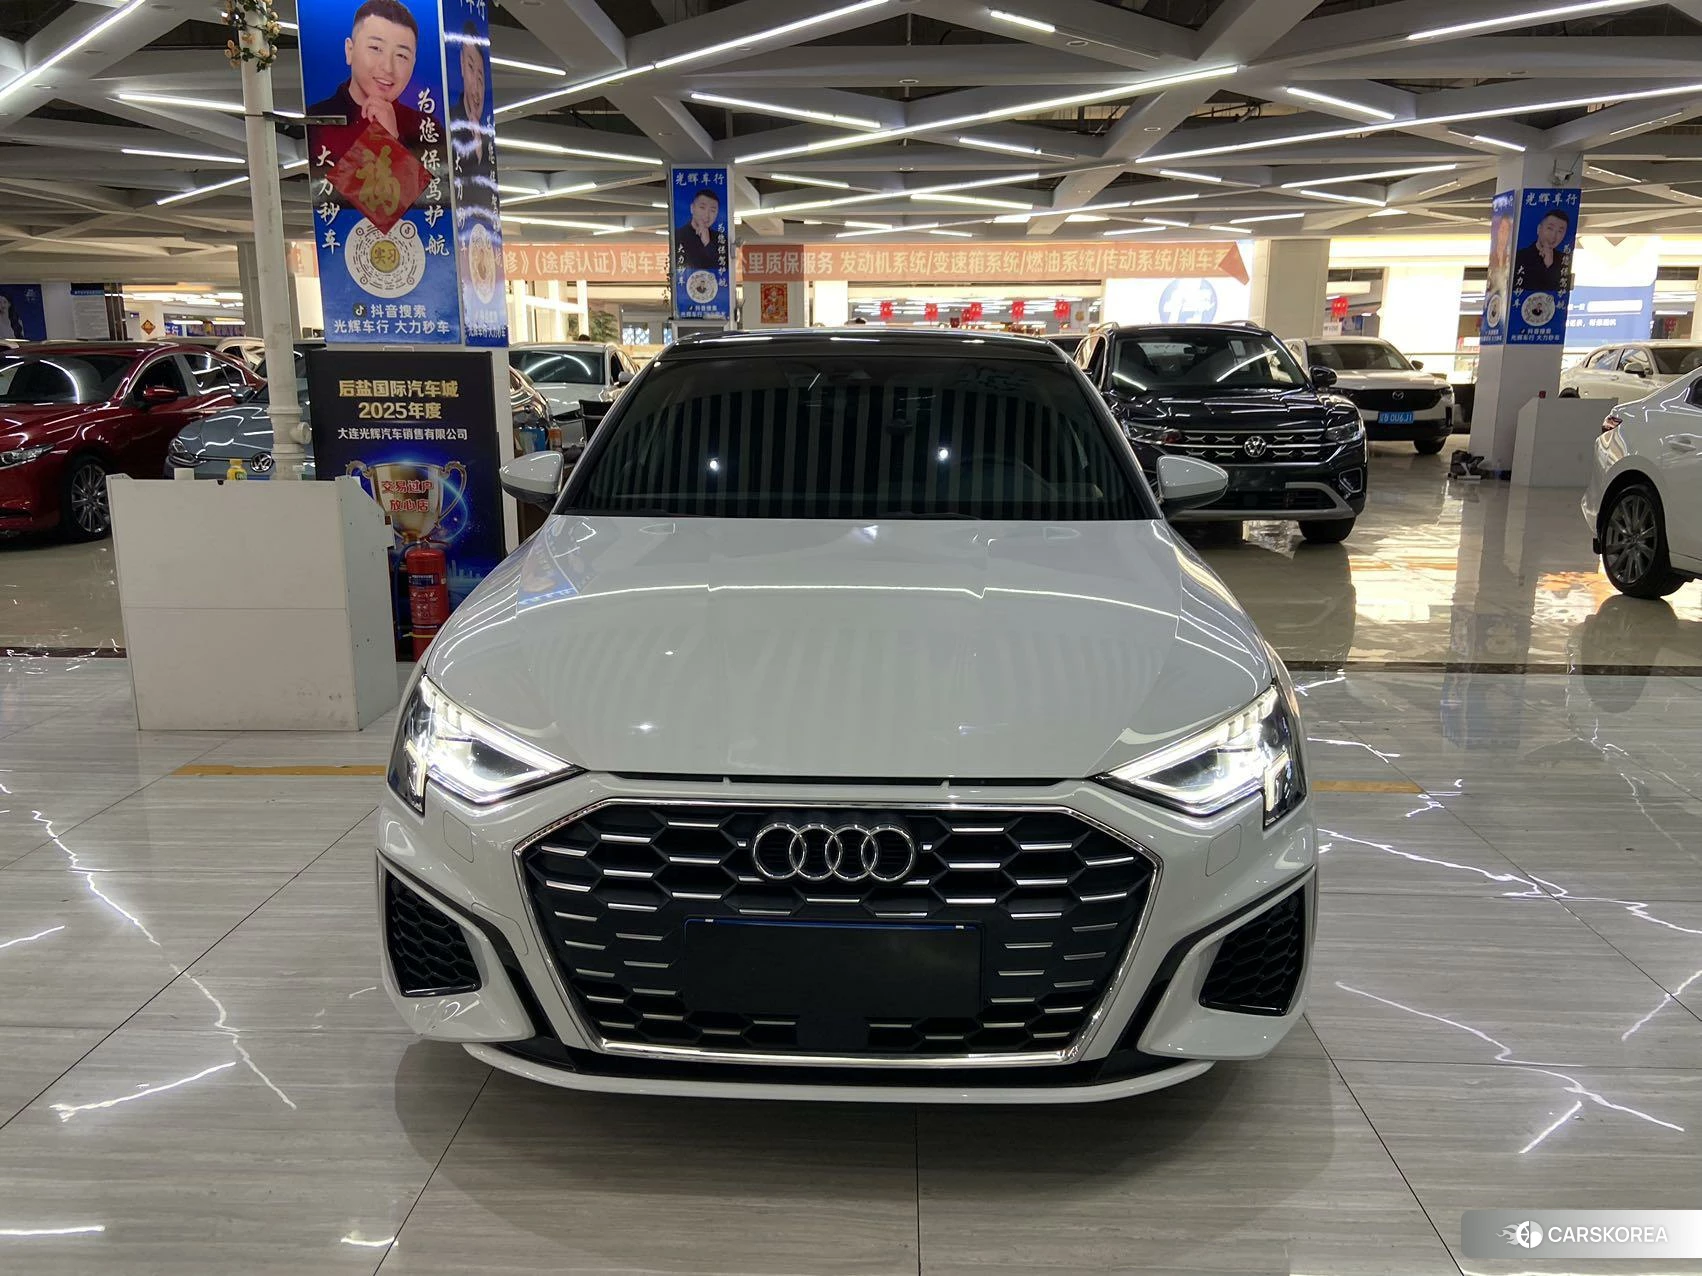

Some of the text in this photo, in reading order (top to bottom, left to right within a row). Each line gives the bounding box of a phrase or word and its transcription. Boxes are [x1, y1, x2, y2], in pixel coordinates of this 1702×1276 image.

[418, 88, 450, 256] 为您保驾护航
[316, 145, 341, 255] 大力秒车
[370, 304, 427, 319] 抖音搜索
[334, 320, 389, 334] 光辉车行
[394, 319, 450, 335] 大力秒车
[338, 380, 460, 398] 后盐国际汽车城
[358, 402, 442, 420] 2025年度
[337, 428, 468, 441] 大连光辉汽车销售有限公司
[381, 479, 434, 494] 交易过户
[390, 499, 429, 513] 放心店
